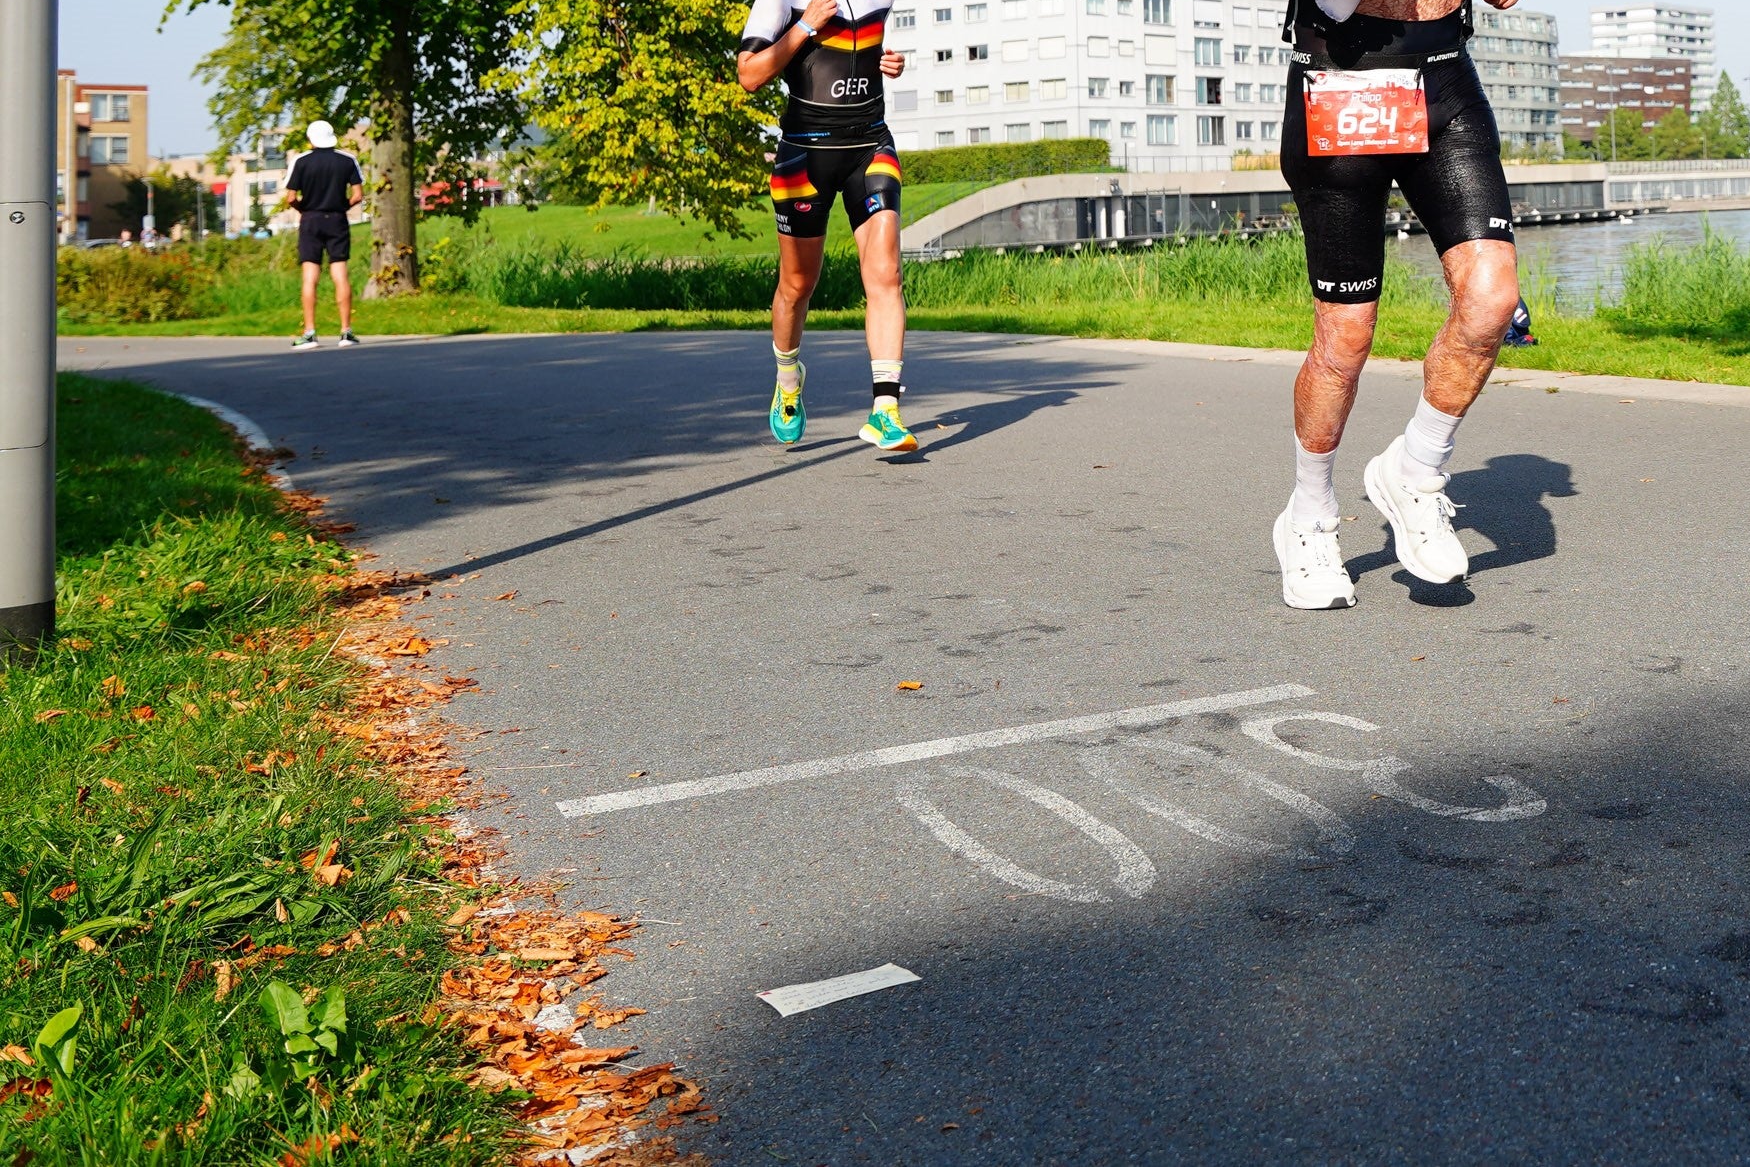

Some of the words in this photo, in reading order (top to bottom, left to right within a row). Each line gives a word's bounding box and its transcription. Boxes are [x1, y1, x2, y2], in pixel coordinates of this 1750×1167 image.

[831, 78, 869, 99] GER
[1337, 106, 1398, 135] 624
[1489, 217, 1507, 229] DT
[1317, 279, 1335, 292] DT
[1339, 277, 1377, 292] SWISS
